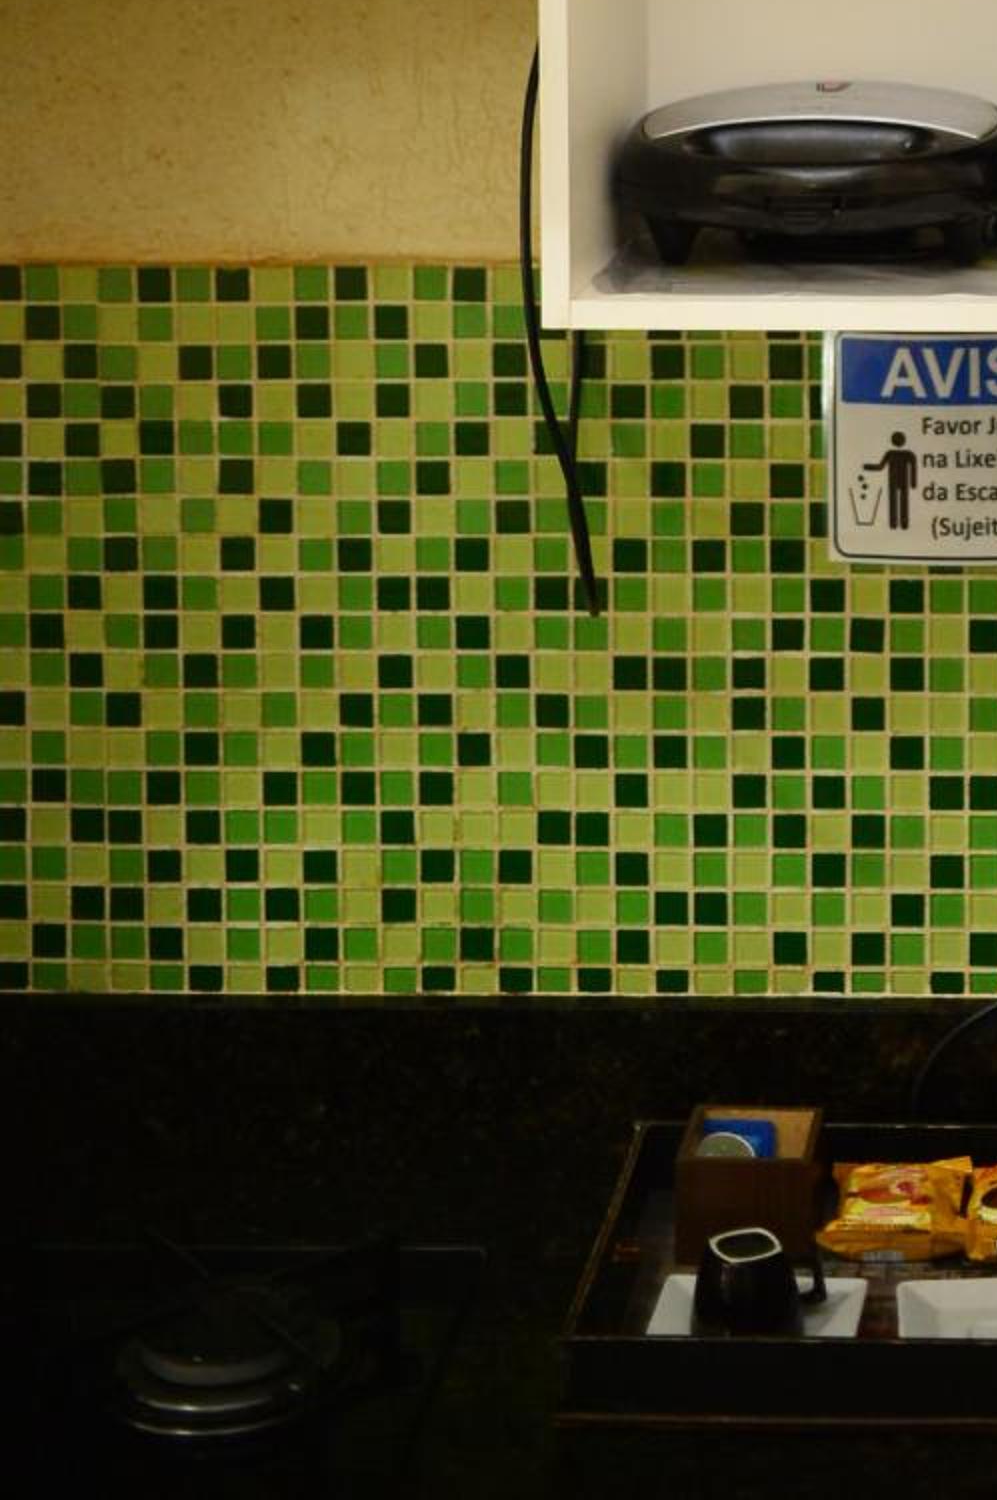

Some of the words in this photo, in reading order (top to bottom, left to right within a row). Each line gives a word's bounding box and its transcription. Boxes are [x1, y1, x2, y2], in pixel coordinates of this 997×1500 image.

[921, 417, 981, 436] Favor
[923, 452, 948, 468] na
[922, 483, 948, 501] da
